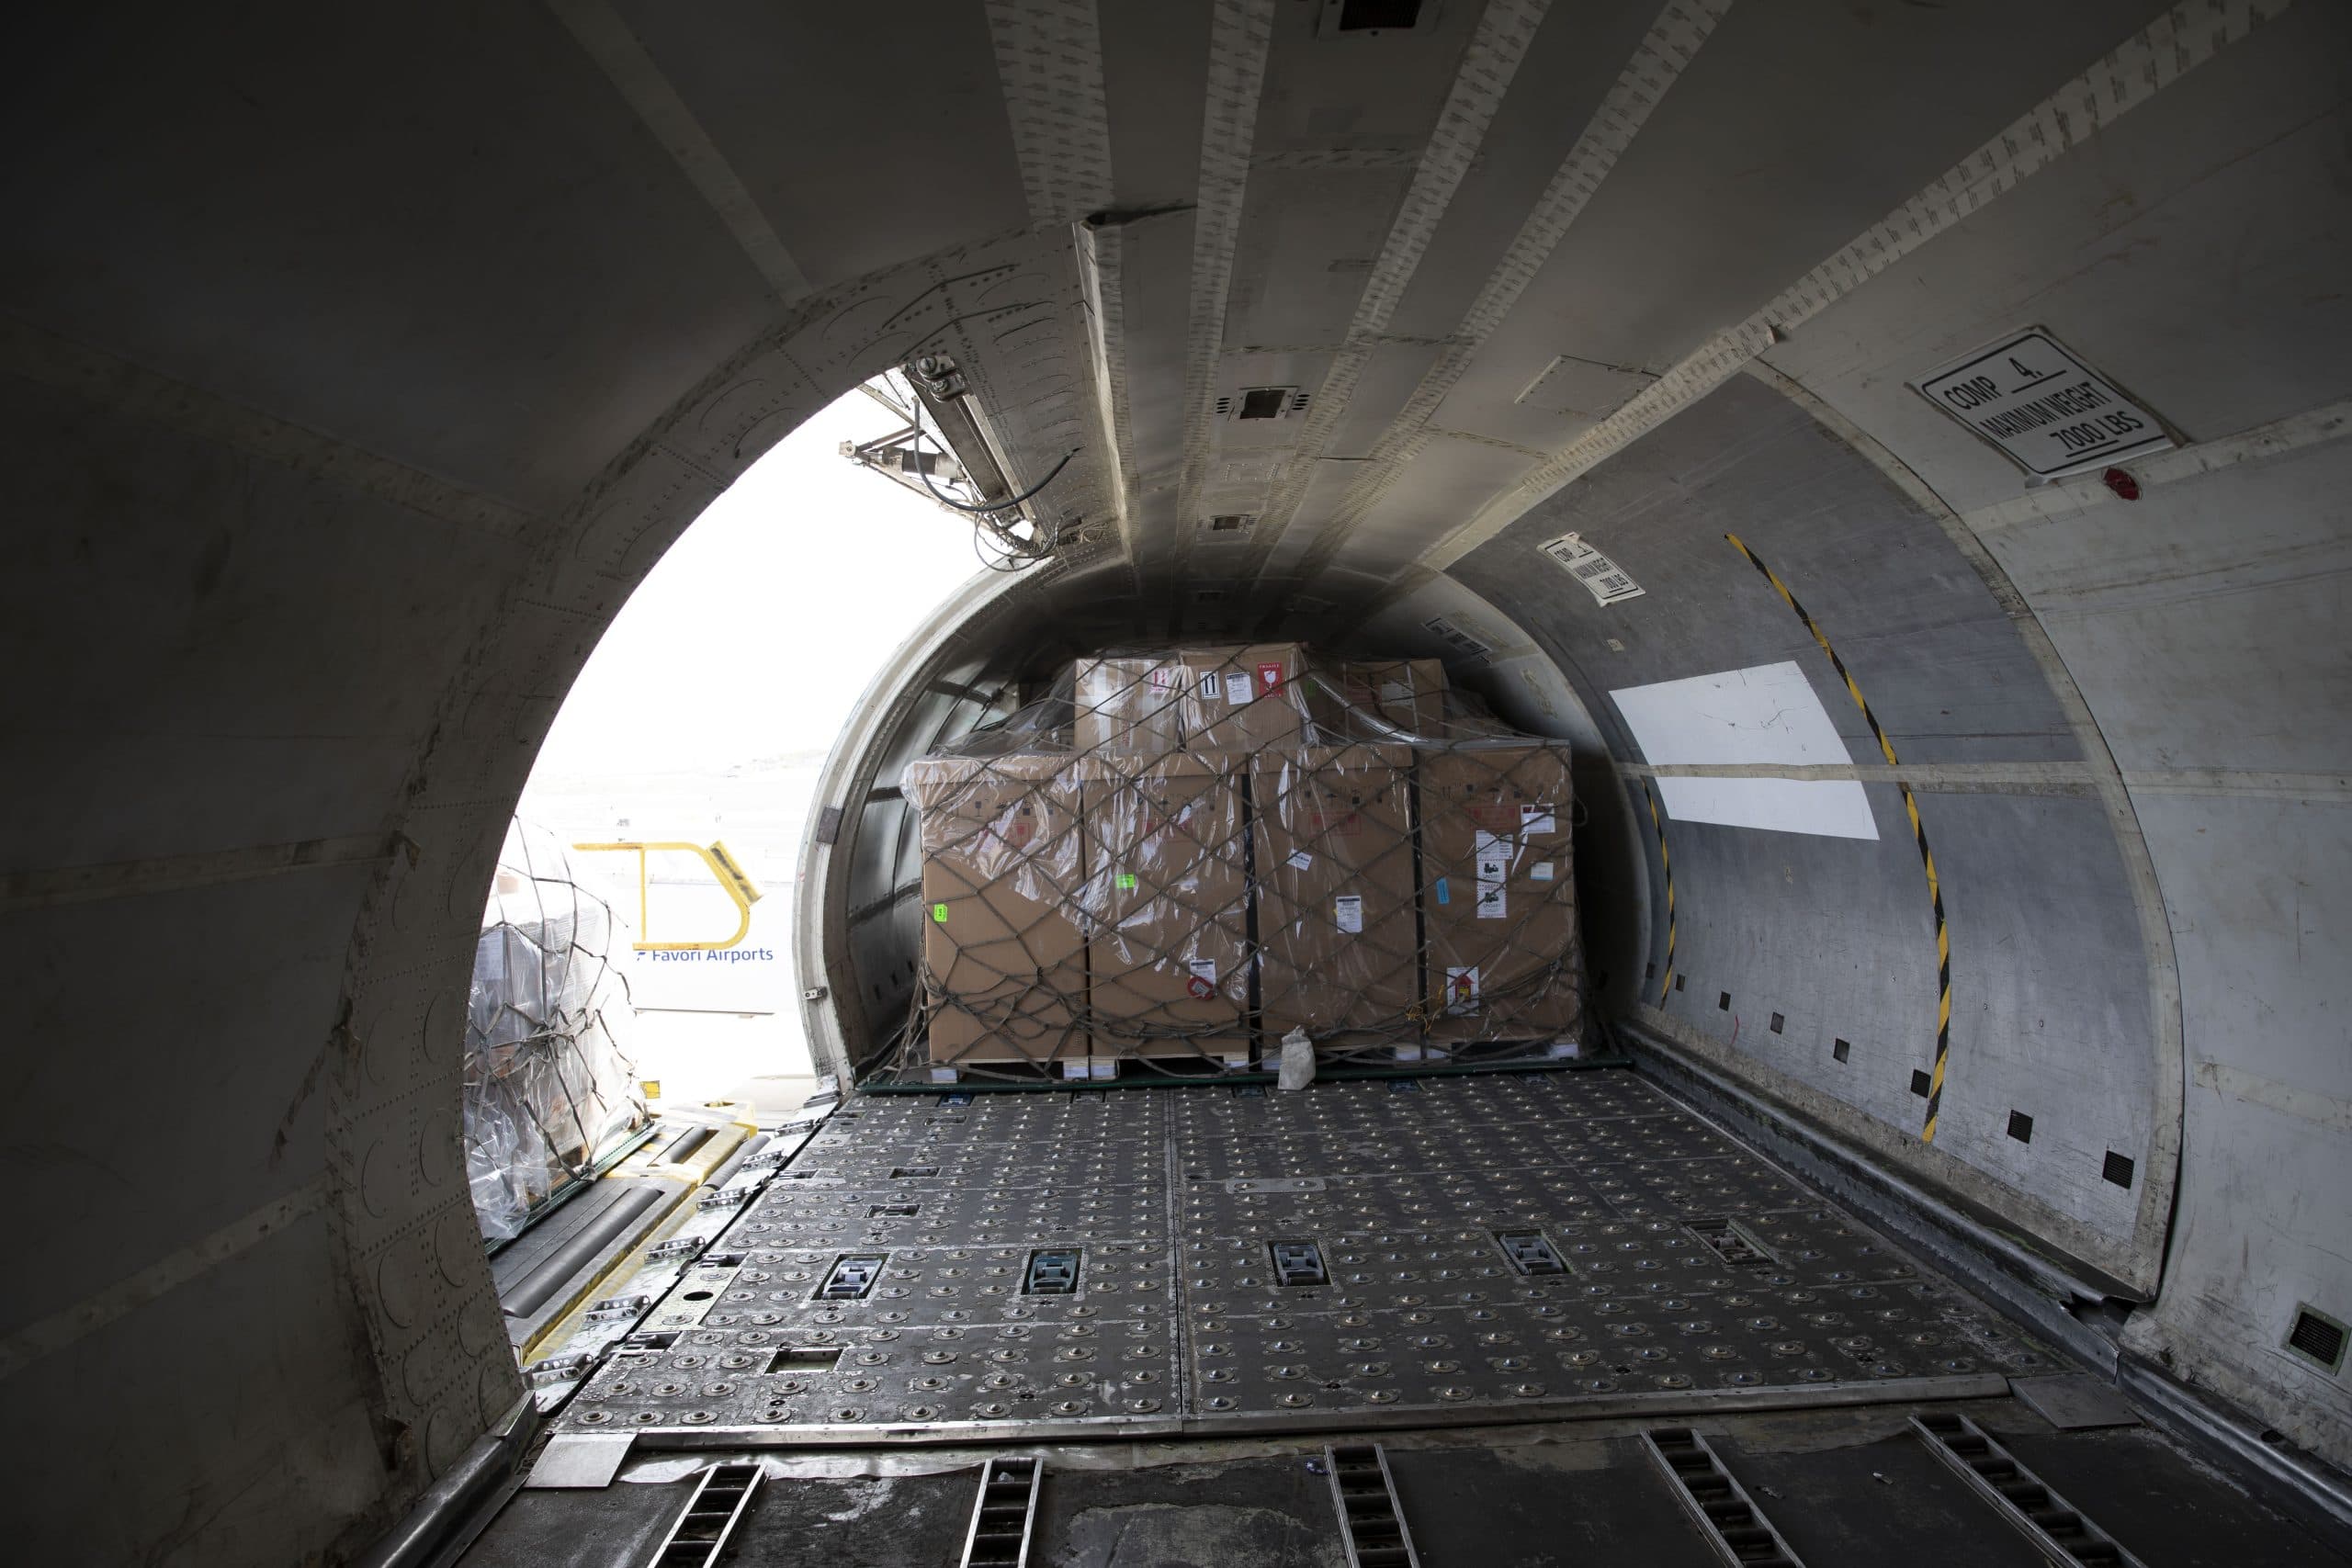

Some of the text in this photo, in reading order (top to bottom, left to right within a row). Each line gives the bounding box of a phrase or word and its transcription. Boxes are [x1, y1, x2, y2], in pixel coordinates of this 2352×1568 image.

[1944, 376, 2003, 410] COMP
[1979, 381, 2112, 440] MAXIMUM WEIGHT
[2049, 411, 2144, 450] 7000 LBS
[652, 948, 774, 964] Favori Airports
